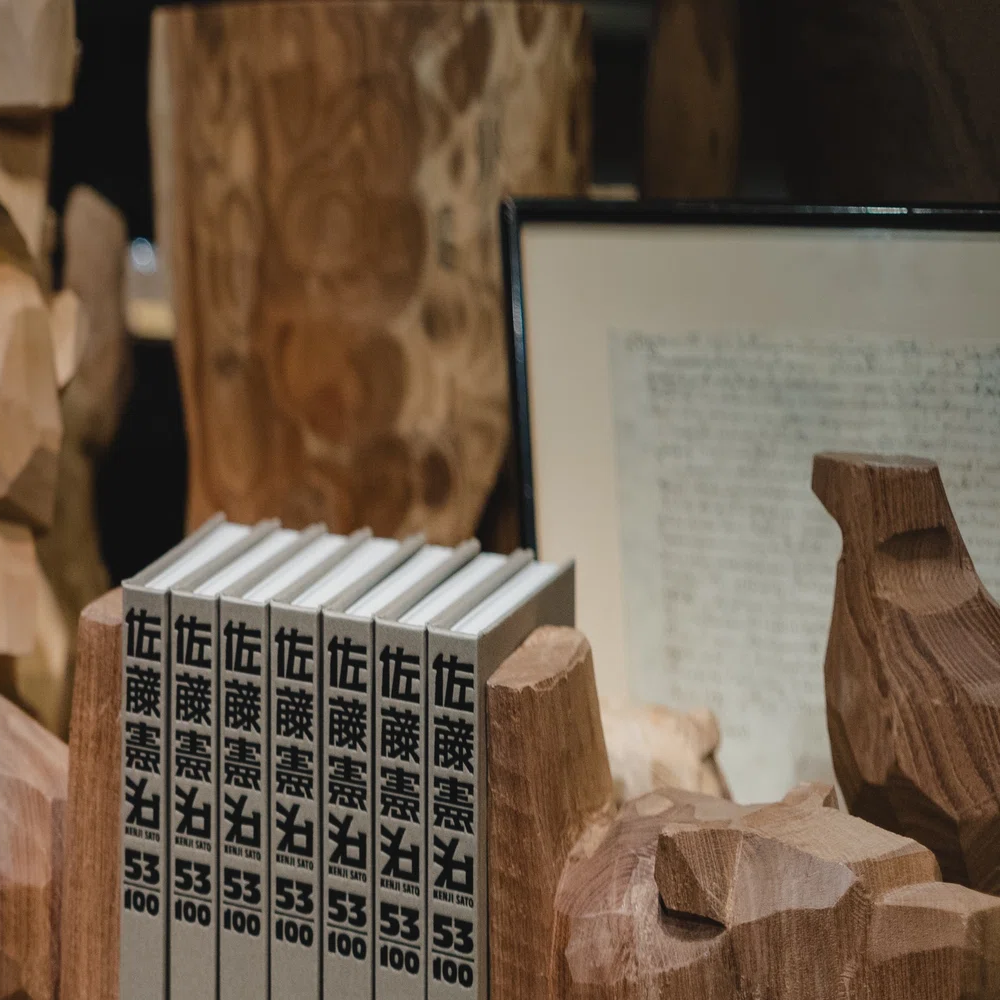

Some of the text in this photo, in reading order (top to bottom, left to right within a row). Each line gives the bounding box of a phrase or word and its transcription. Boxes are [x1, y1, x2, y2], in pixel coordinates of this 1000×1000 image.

[125, 826, 160, 842] KENJI SATO
[175, 836, 211, 851] KENJI SATO
[125, 848, 160, 885] 53
[224, 844, 261, 861] KENJI SATO
[276, 854, 313, 870] KENJI SATO
[175, 858, 211, 895] 53
[224, 867, 261, 904] 53
[329, 865, 367, 882] KENJI SATO
[380, 878, 420, 896] KENJI SATO
[124, 889, 159, 916] 100
[276, 876, 313, 914] 53
[328, 888, 367, 927] 53
[433, 889, 473, 908] KENJI SATO
[175, 899, 211, 926] 100
[224, 909, 260, 936] 100
[380, 901, 420, 941] 53
[276, 919, 313, 947] 100
[328, 931, 366, 960] 100
[433, 913, 474, 954] 53
[380, 945, 419, 974] 100
[433, 957, 473, 988] 100
